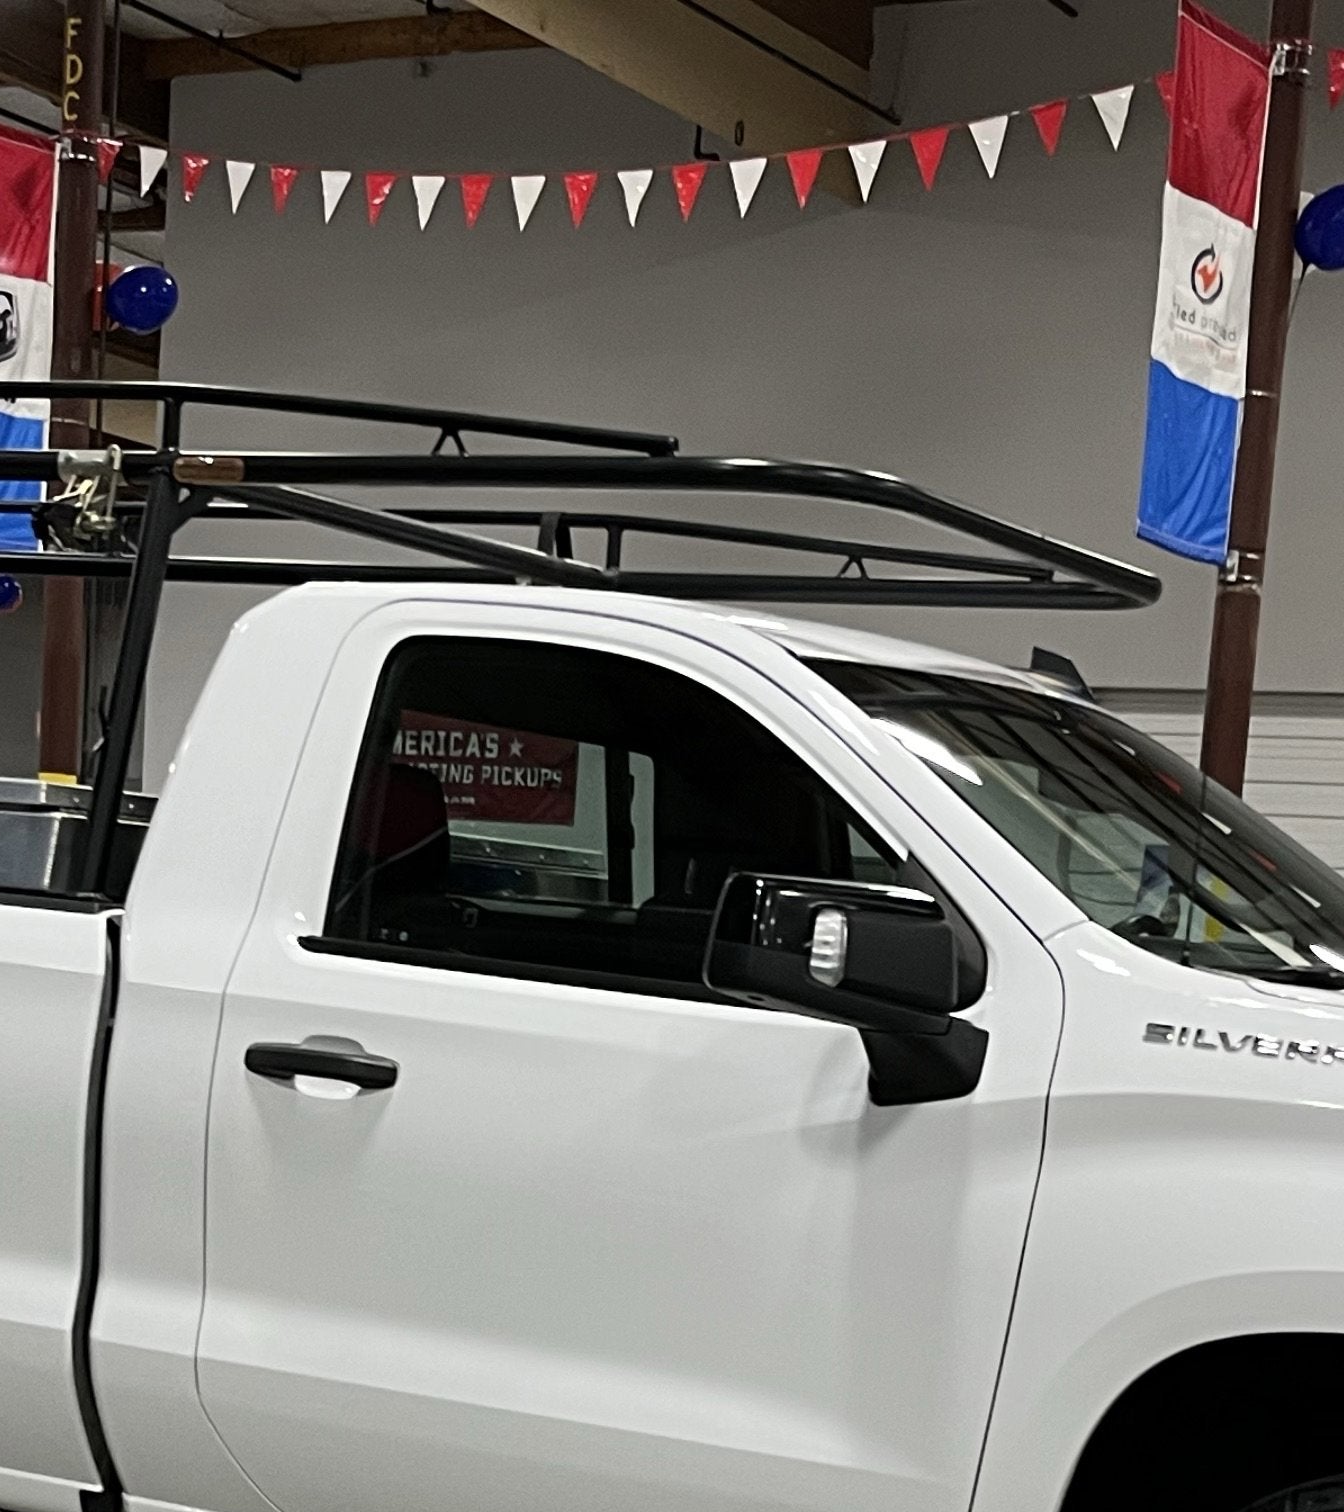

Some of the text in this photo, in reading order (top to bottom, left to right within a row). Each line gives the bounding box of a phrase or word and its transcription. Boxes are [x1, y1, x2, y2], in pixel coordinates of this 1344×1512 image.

[63, 18, 83, 120] FDC
[392, 730, 500, 758] MERICA'S
[481, 766, 562, 789] PICKUPS
